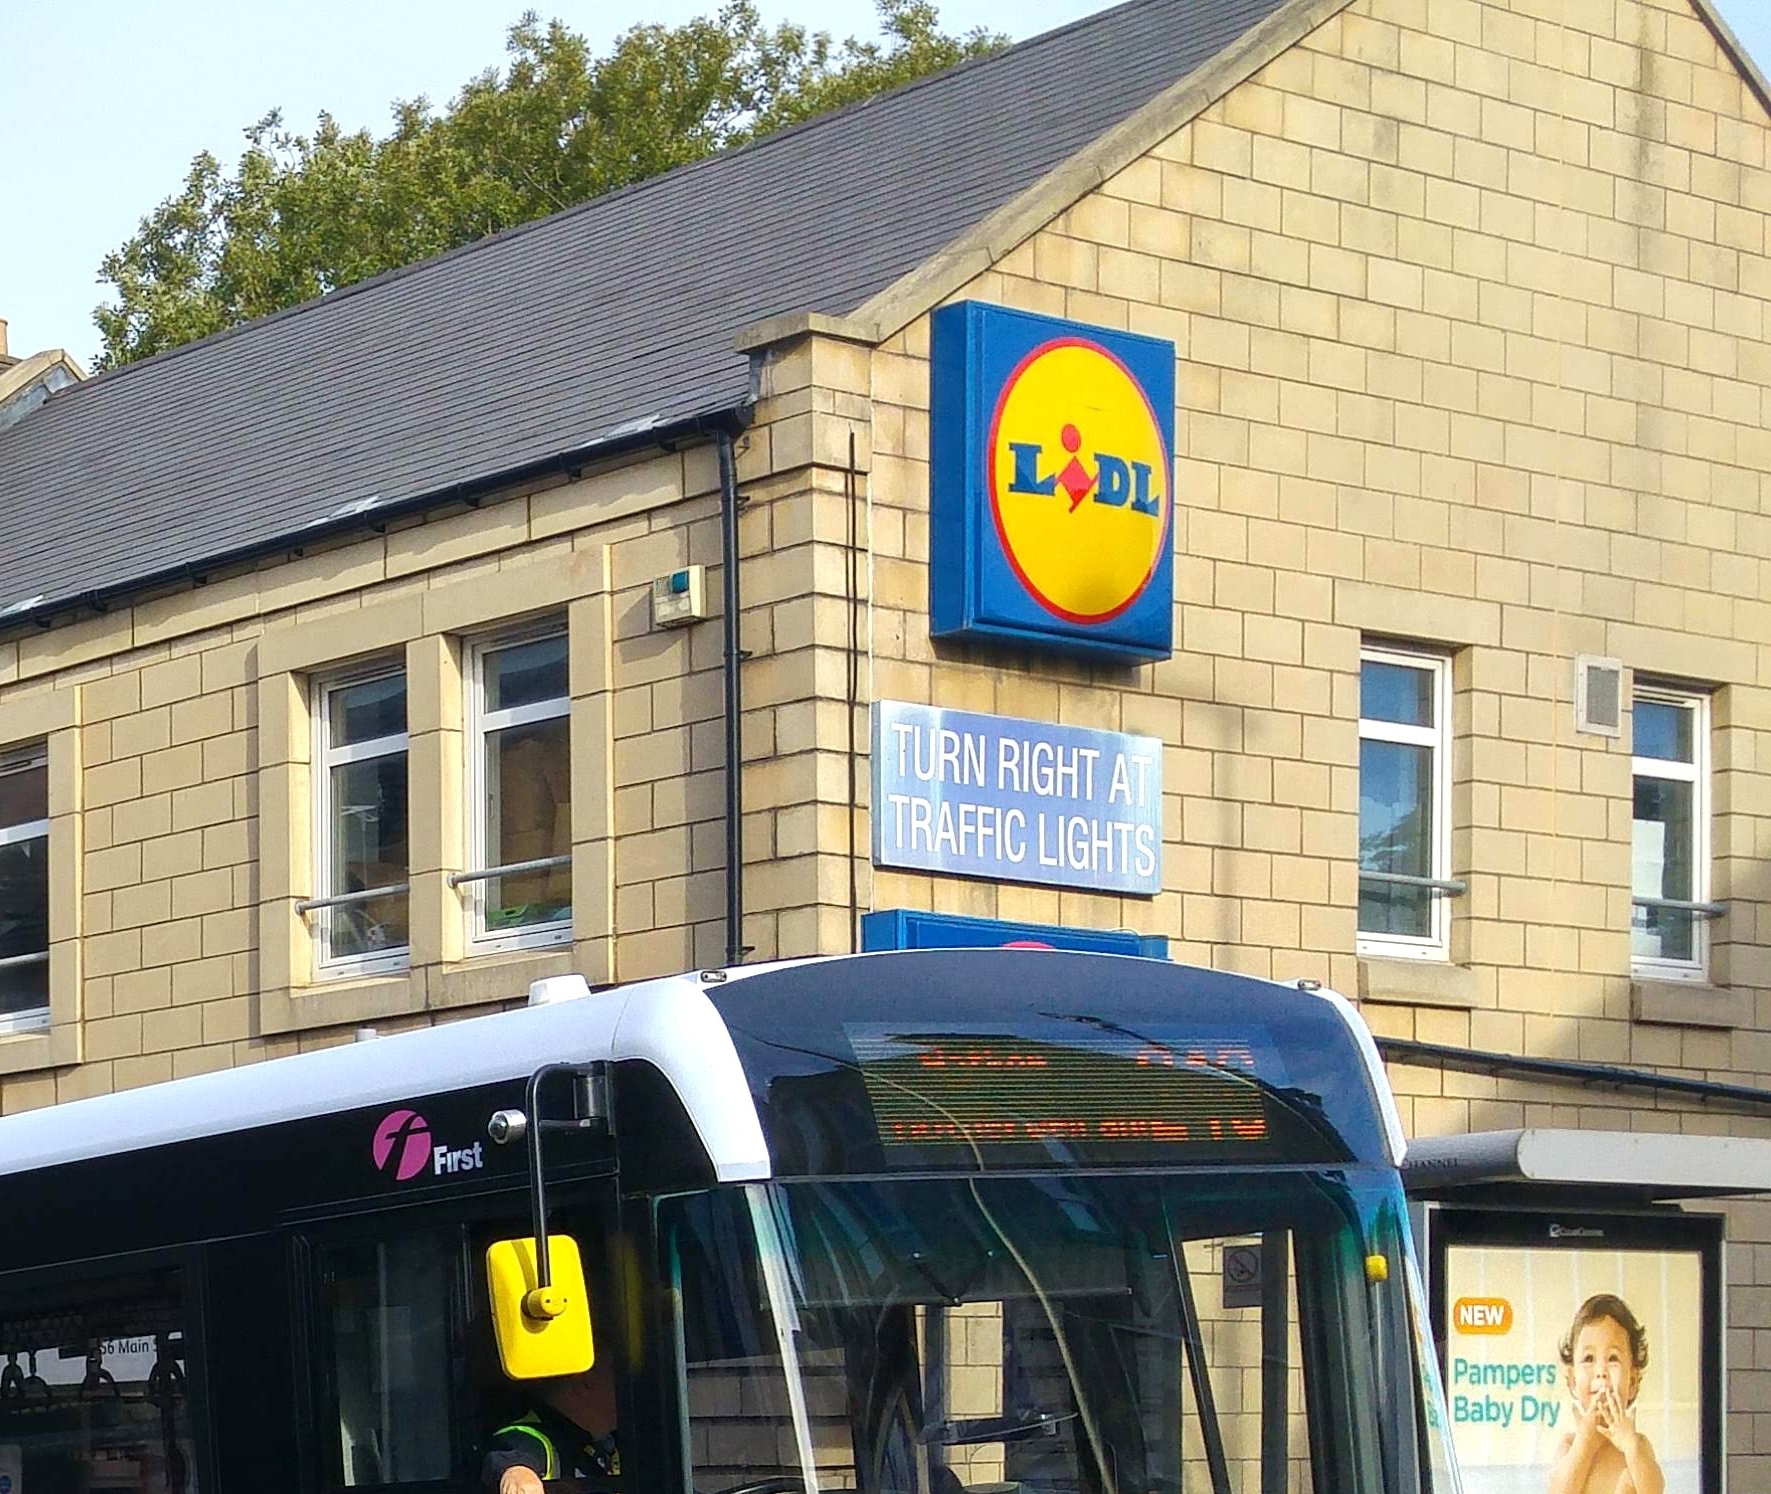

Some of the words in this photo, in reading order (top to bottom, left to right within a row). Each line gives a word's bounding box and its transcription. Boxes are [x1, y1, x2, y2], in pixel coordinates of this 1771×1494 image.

[891, 722, 986, 787] TURN
[998, 737, 1099, 801] RIGHT
[1109, 753, 1152, 807] AT
[887, 794, 1026, 863] TRAFFIC
[1038, 813, 1156, 877] LIGHTS
[433, 1141, 484, 1175] First
[1459, 1304, 1505, 1327] NEW
[118, 1339, 149, 1354] Main
[1454, 1358, 1556, 1391] Pampers
[1454, 1394, 1513, 1428] Baby
[1521, 1395, 1560, 1427] Dry
